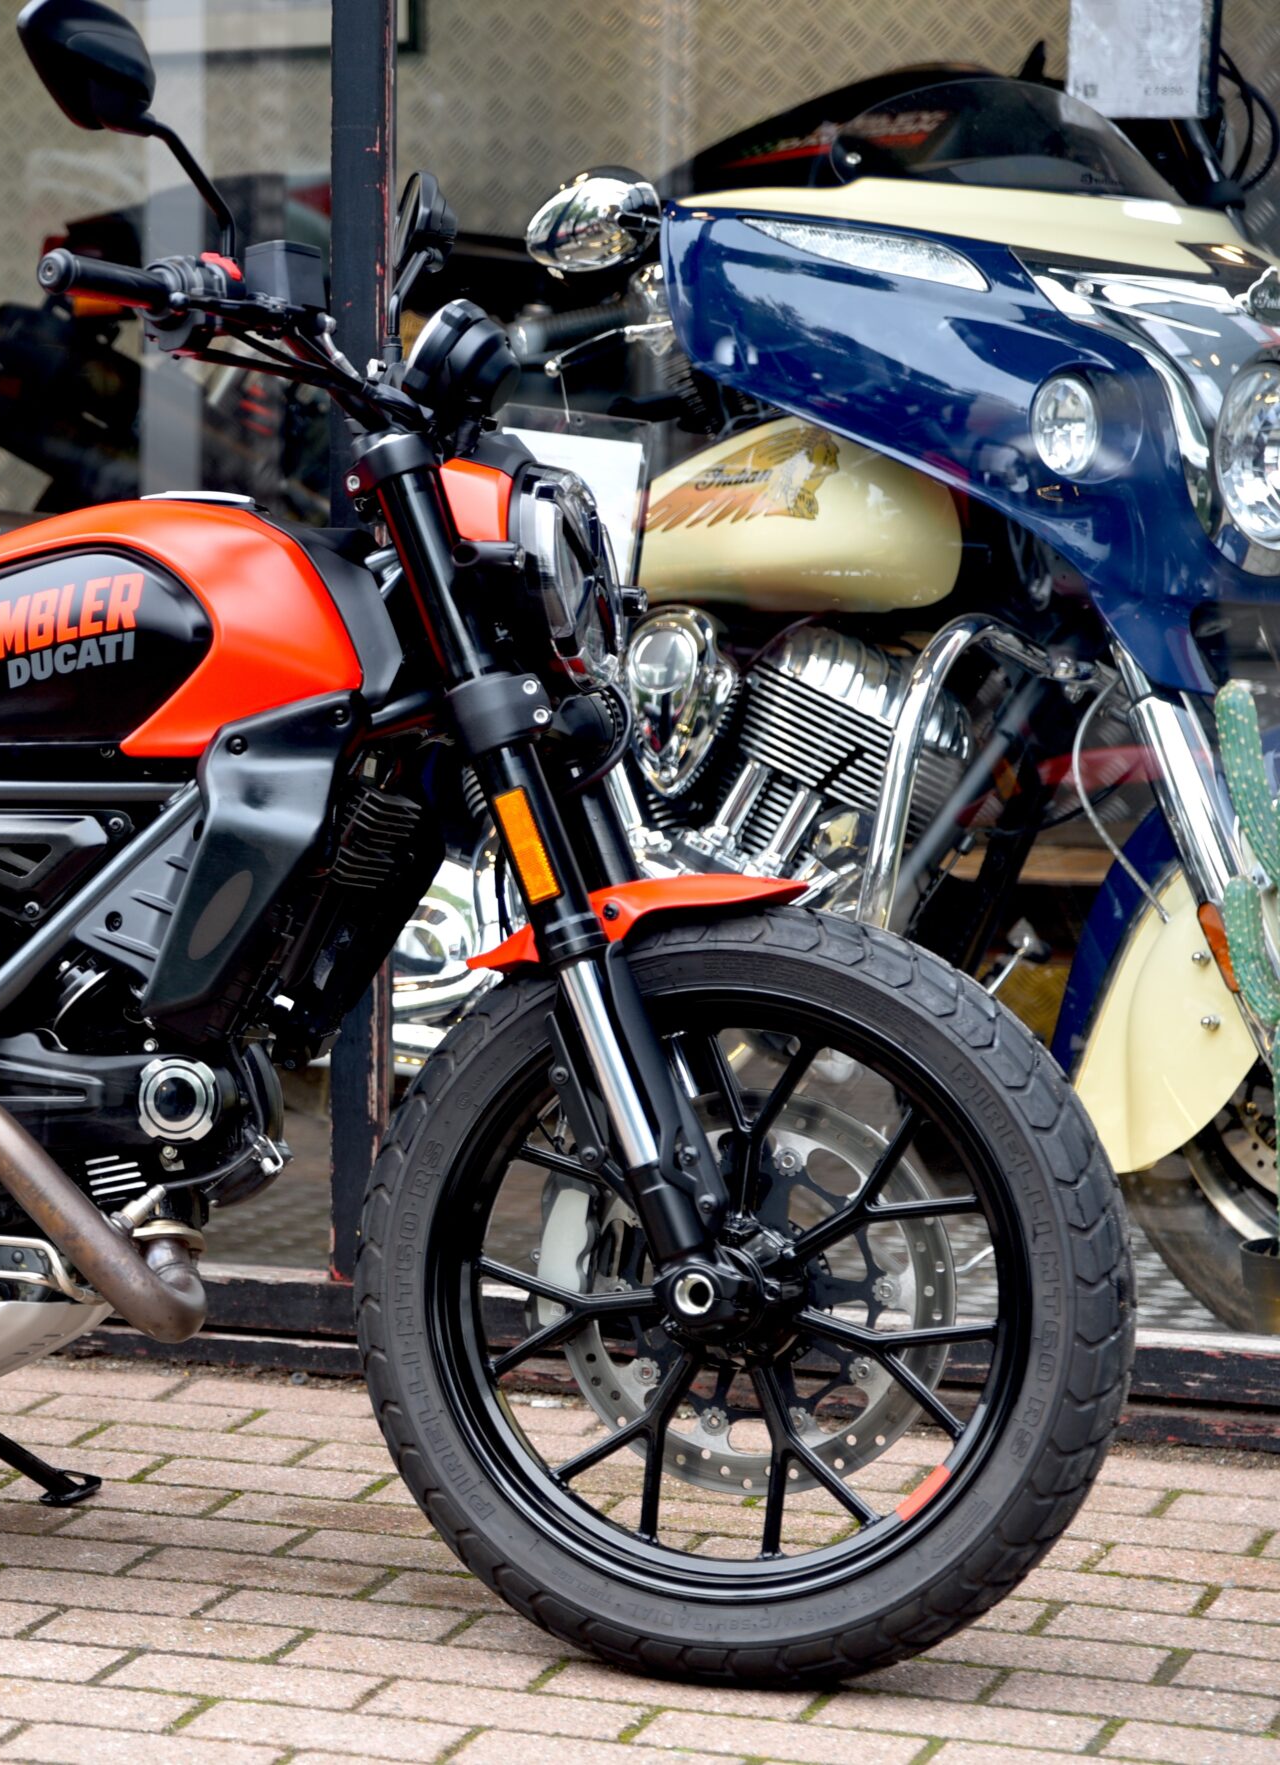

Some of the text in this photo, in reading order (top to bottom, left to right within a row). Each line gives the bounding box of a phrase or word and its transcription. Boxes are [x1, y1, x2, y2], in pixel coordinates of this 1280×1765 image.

[695, 465, 772, 491] Indian
[7, 631, 135, 689] DUCATI
[947, 1061, 1053, 1235] PIRELLI
[394, 1138, 497, 1521] PIRELLI MT60 RS
